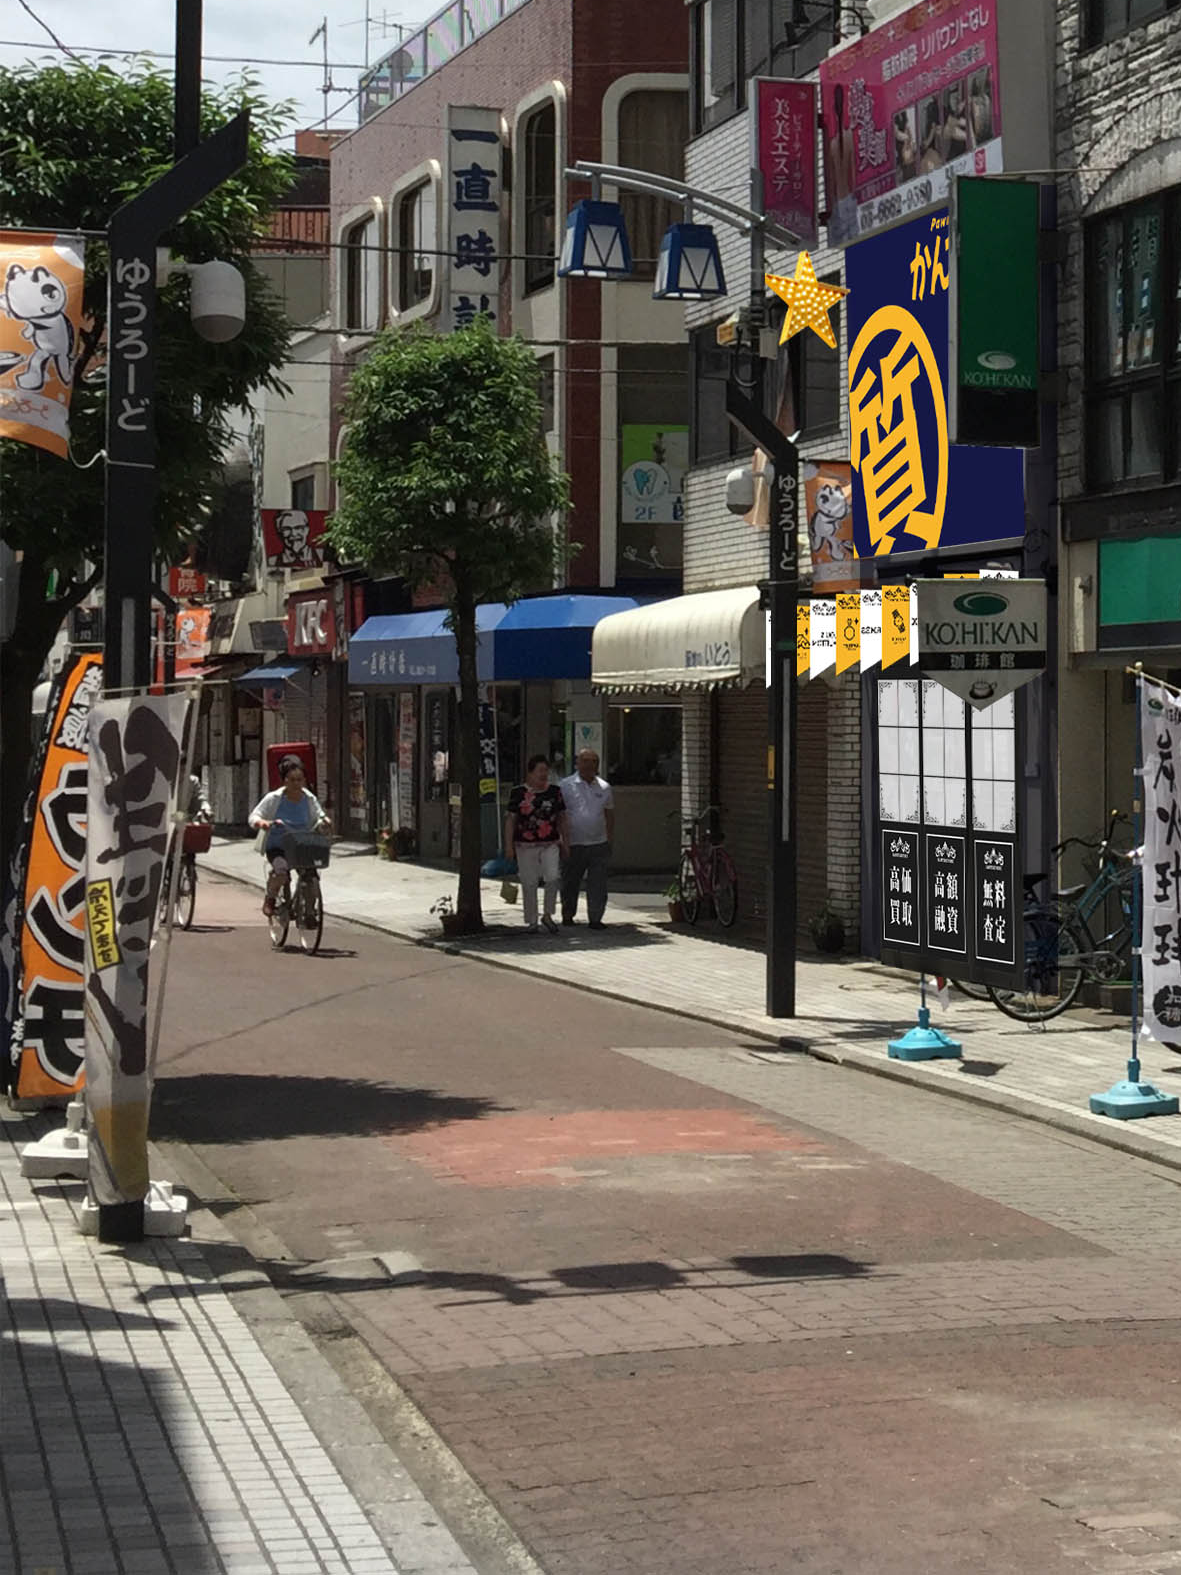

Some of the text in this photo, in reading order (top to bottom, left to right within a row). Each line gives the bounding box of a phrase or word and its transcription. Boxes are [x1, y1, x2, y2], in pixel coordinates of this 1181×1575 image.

[770, 98, 789, 194] 美美エステ
[910, 235, 949, 301] かん
[114, 258, 152, 433] ゆうろーど
[850, 333, 939, 558] 質
[779, 475, 796, 571] ゆうろーど
[294, 599, 328, 646] KFC
[950, 653, 1016, 669] 珈琲館
[889, 865, 912, 893] 高価
[934, 871, 959, 900] 高額
[983, 879, 1006, 909] 無料
[890, 898, 912, 926] 買取
[934, 905, 959, 934] 融資
[984, 914, 1006, 944] 査定
